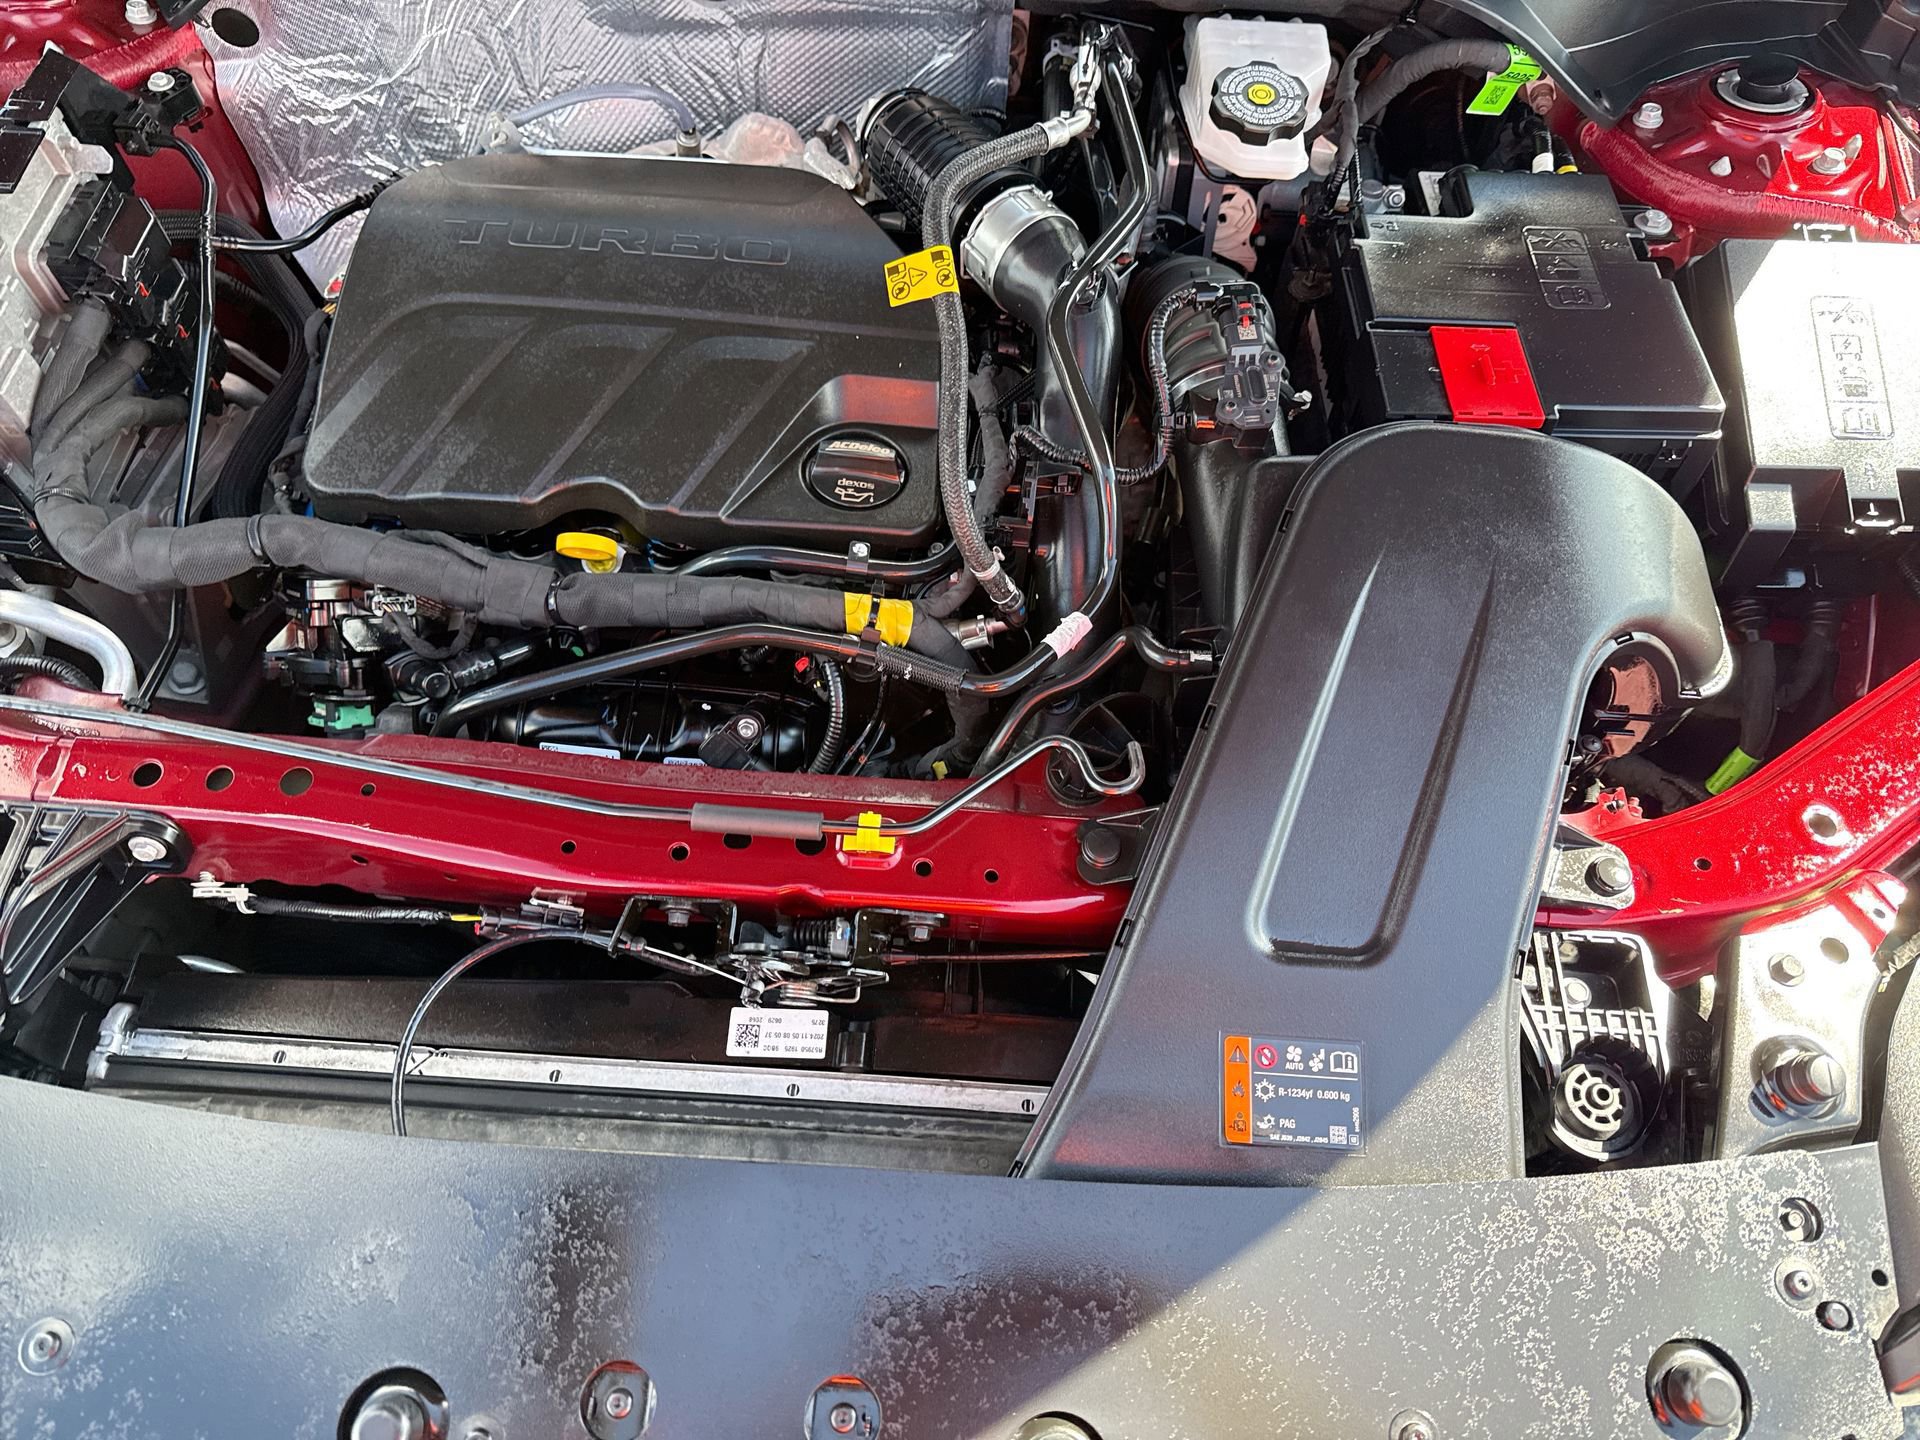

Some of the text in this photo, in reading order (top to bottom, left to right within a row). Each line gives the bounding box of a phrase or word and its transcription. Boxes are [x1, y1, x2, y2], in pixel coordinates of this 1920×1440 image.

[444, 219, 791, 265] TURBO
[828, 440, 890, 455] ACDelco
[837, 478, 875, 490] dexos
[1285, 1062, 1304, 1071] AUTO
[1278, 1087, 1351, 1102] R-1234yf 0.600 kg
[1279, 1118, 1296, 1129] PAG
